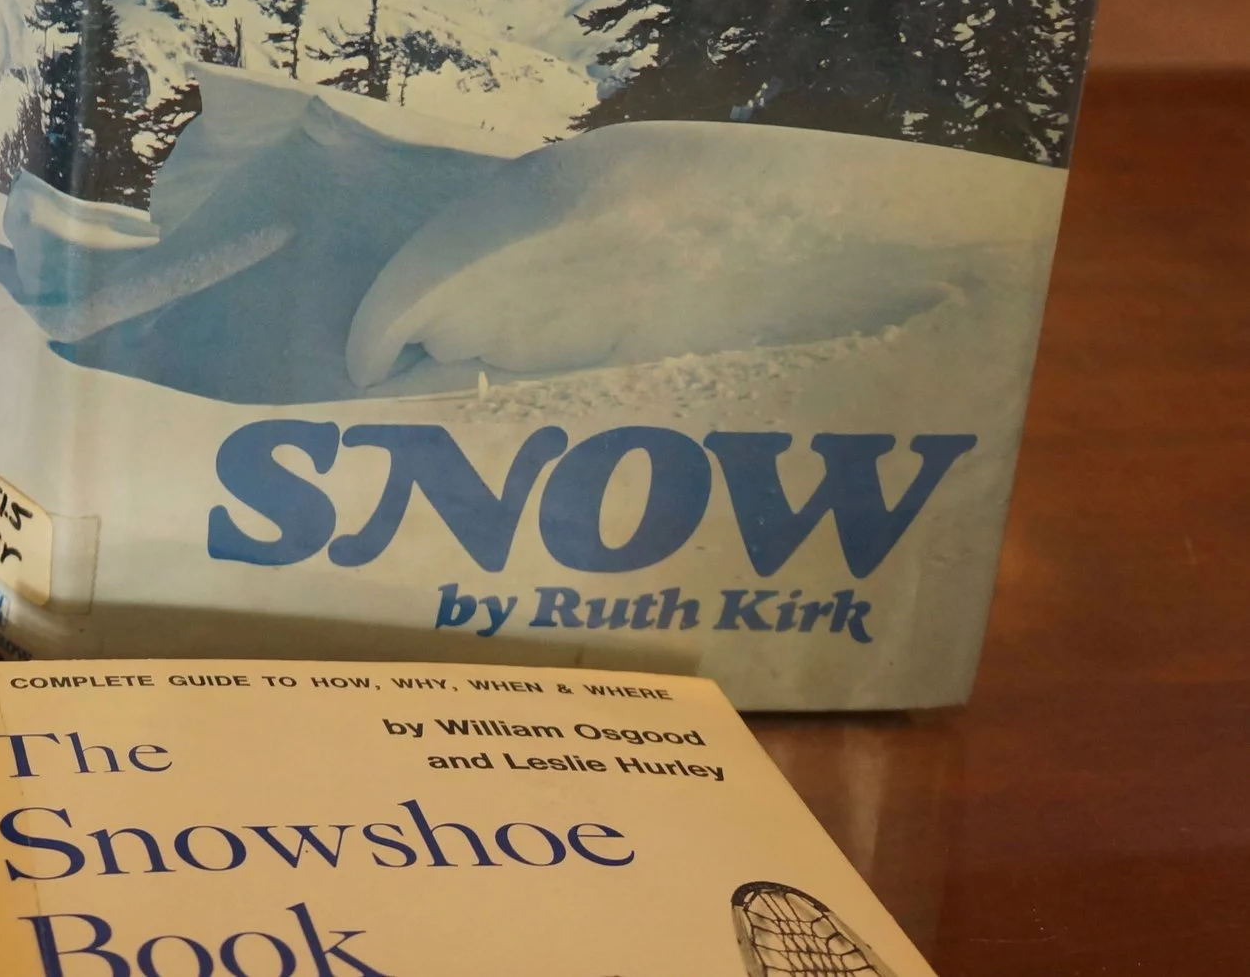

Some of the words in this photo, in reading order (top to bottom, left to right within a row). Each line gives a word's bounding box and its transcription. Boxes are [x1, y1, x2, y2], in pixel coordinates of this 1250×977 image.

[207, 418, 978, 580] SNOW
[435, 583, 518, 638] by
[527, 585, 701, 632] Ruth
[712, 587, 874, 644] Kirk
[10, 675, 155, 690] COMPLETE
[168, 675, 251, 687] GUIDE
[261, 676, 298, 688] TO
[310, 677, 381, 690] HOW,
[390, 677, 458, 692] WHY,
[467, 679, 544, 694] WHEN
[556, 682, 574, 695] &
[582, 684, 674, 701] WHERE
[382, 717, 425, 738] by
[434, 718, 565, 739] William
[573, 722, 707, 748] Osgood
[427, 752, 495, 771] and
[502, 752, 608, 773] Leslie
[614, 755, 726, 782] Hurley
[16, 901, 397, 977] Book
